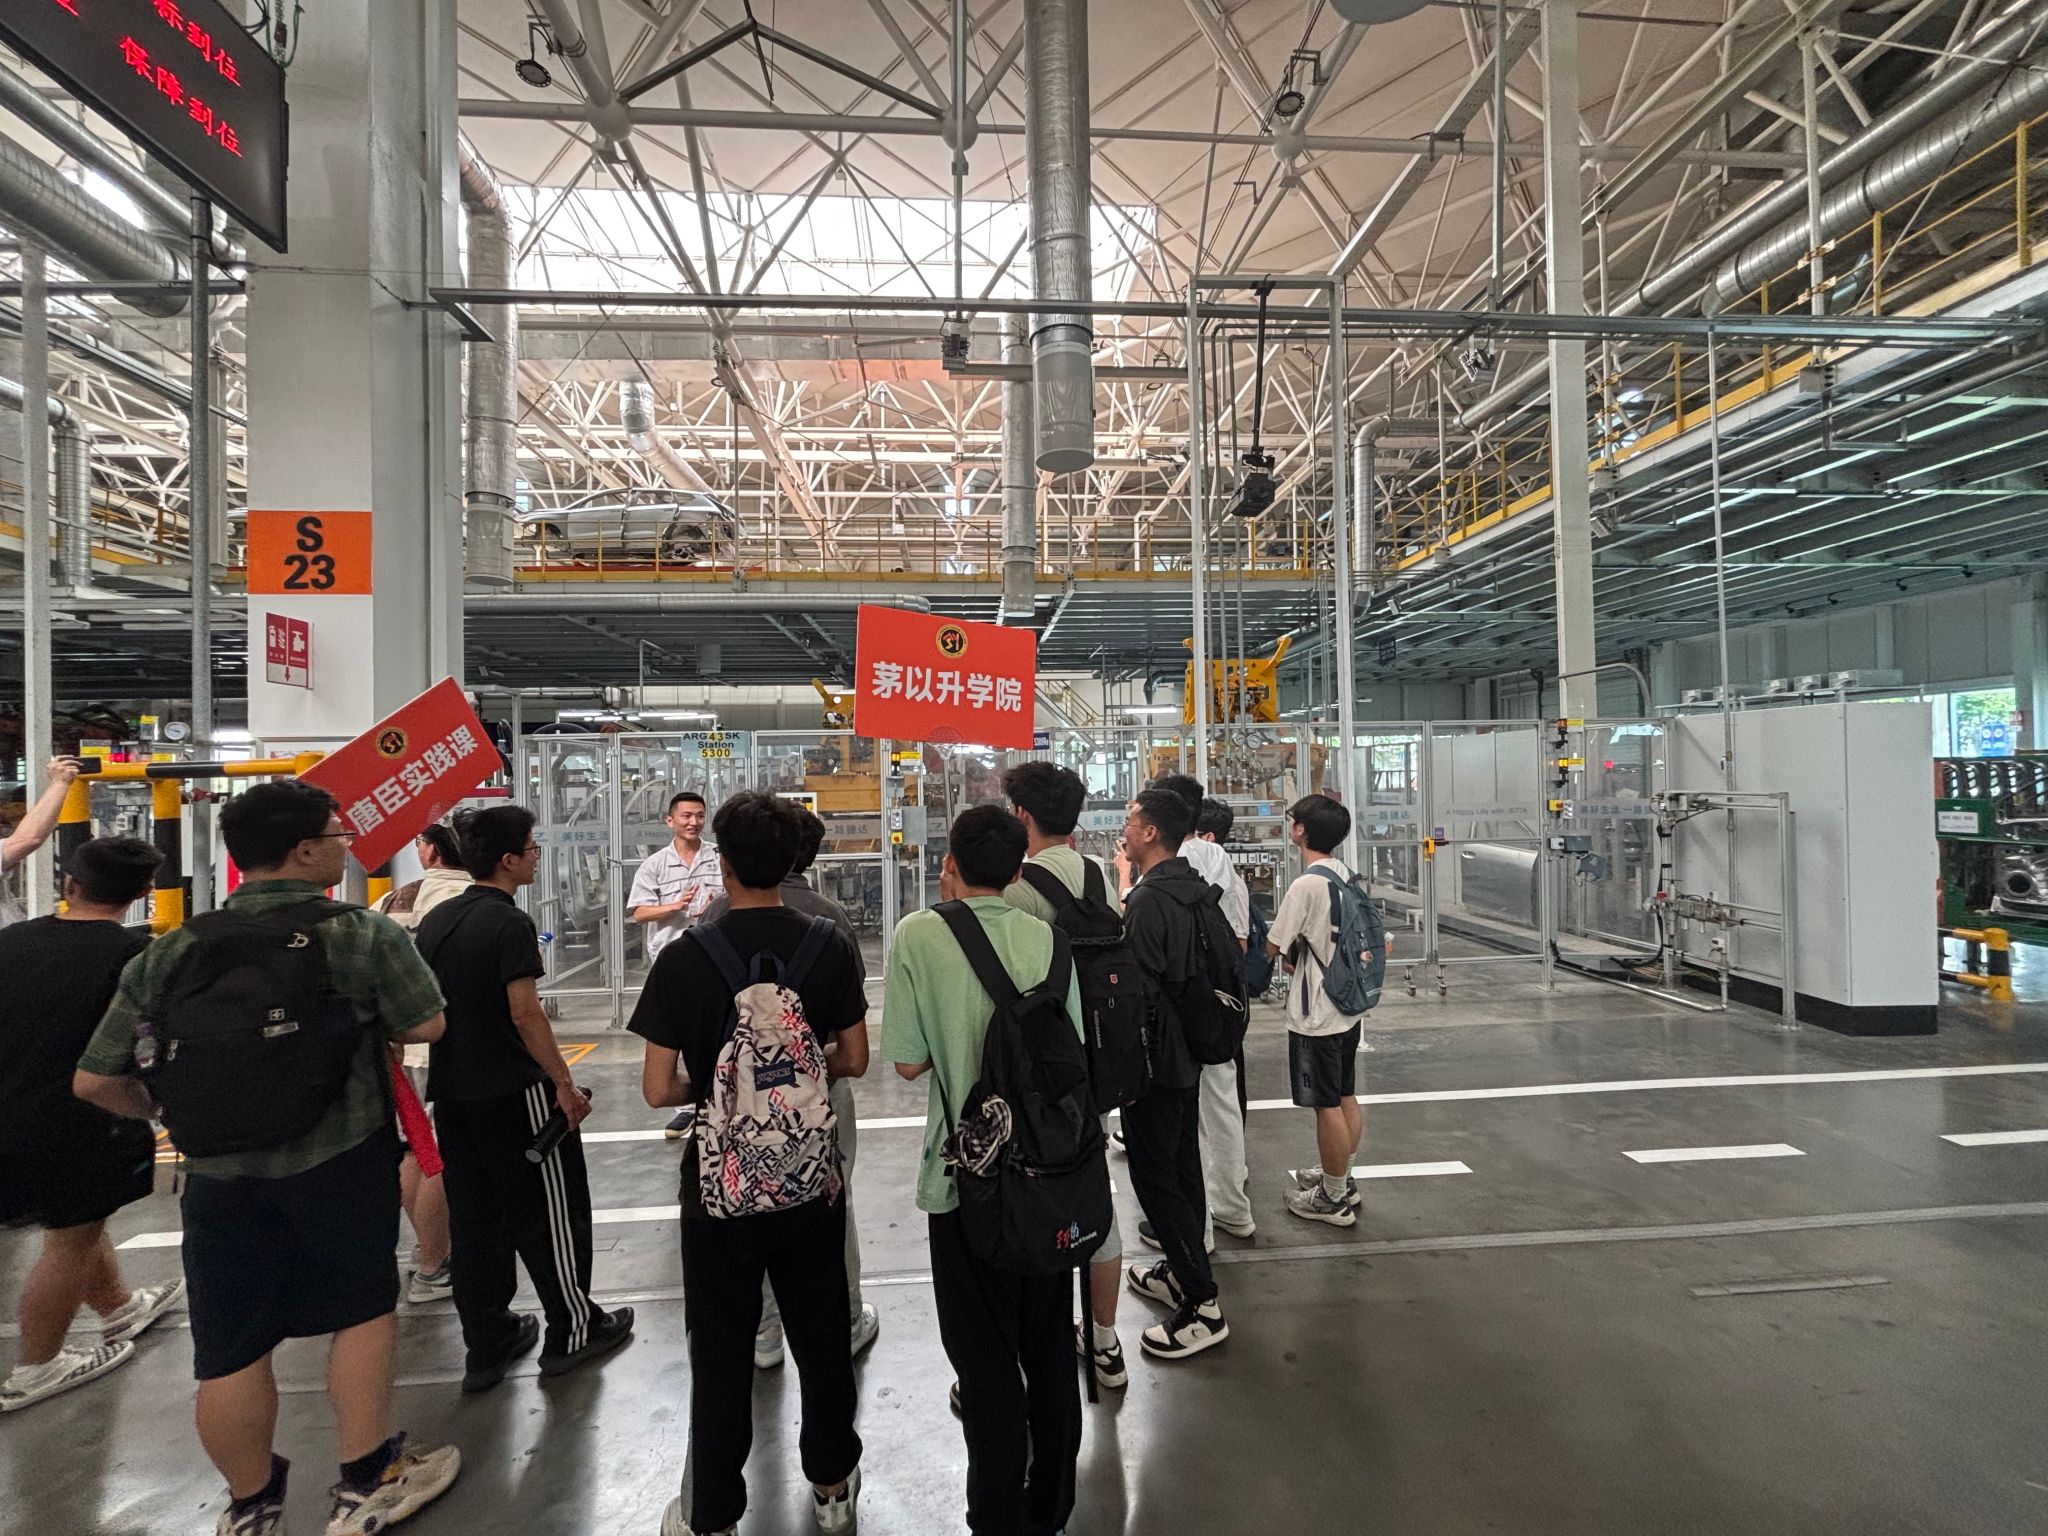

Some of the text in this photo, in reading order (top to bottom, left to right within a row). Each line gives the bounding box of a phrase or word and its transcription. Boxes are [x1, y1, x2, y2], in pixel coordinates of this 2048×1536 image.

[119, 37, 243, 158] 保障到位
[296, 516, 324, 553] S
[283, 555, 335, 590] 23
[872, 660, 1022, 713] 茅以升学院
[697, 741, 734, 749] Station
[702, 748, 731, 758] 5300
[345, 724, 479, 837] 唐臣实践课
